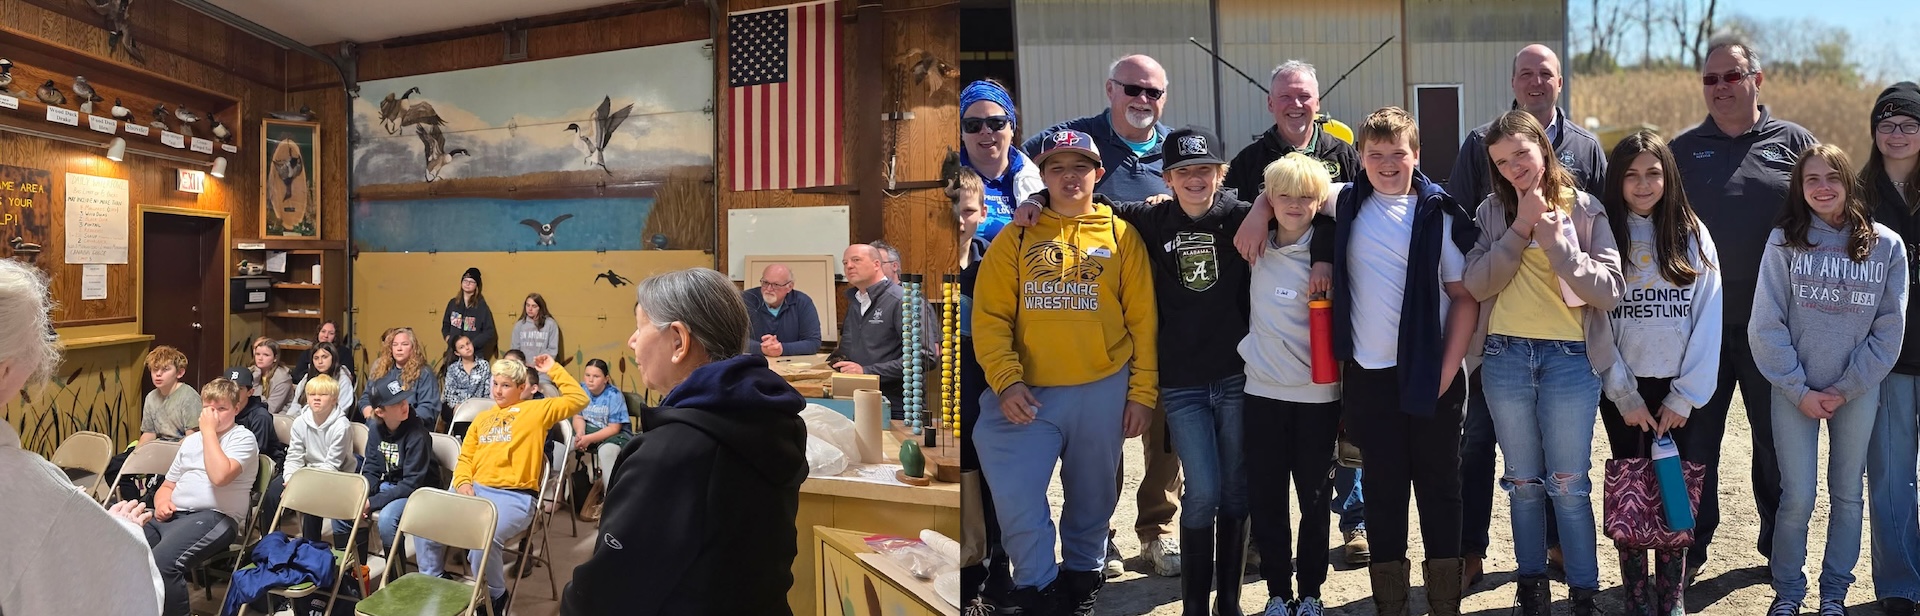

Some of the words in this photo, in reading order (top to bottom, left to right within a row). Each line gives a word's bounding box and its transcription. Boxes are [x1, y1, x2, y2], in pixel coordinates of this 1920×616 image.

[49, 106, 64, 116] Wood
[64, 110, 77, 118] Duck
[56, 115, 71, 123] Drake
[0, 181, 15, 191] ME
[20, 182, 44, 194] AREA
[8, 197, 33, 208] YOUR
[0, 213, 18, 226] P!
[1186, 260, 1207, 282] A
[1820, 256, 1884, 283] ANTONIO
[1024, 281, 1099, 296] ALGONAC
[1619, 288, 1691, 303] LGONAC
[1791, 283, 1840, 302] TEXAS
[1024, 296, 1098, 311] WRESTLING
[1853, 292, 1872, 305] USA
[1611, 304, 1690, 319] WRESTLING
